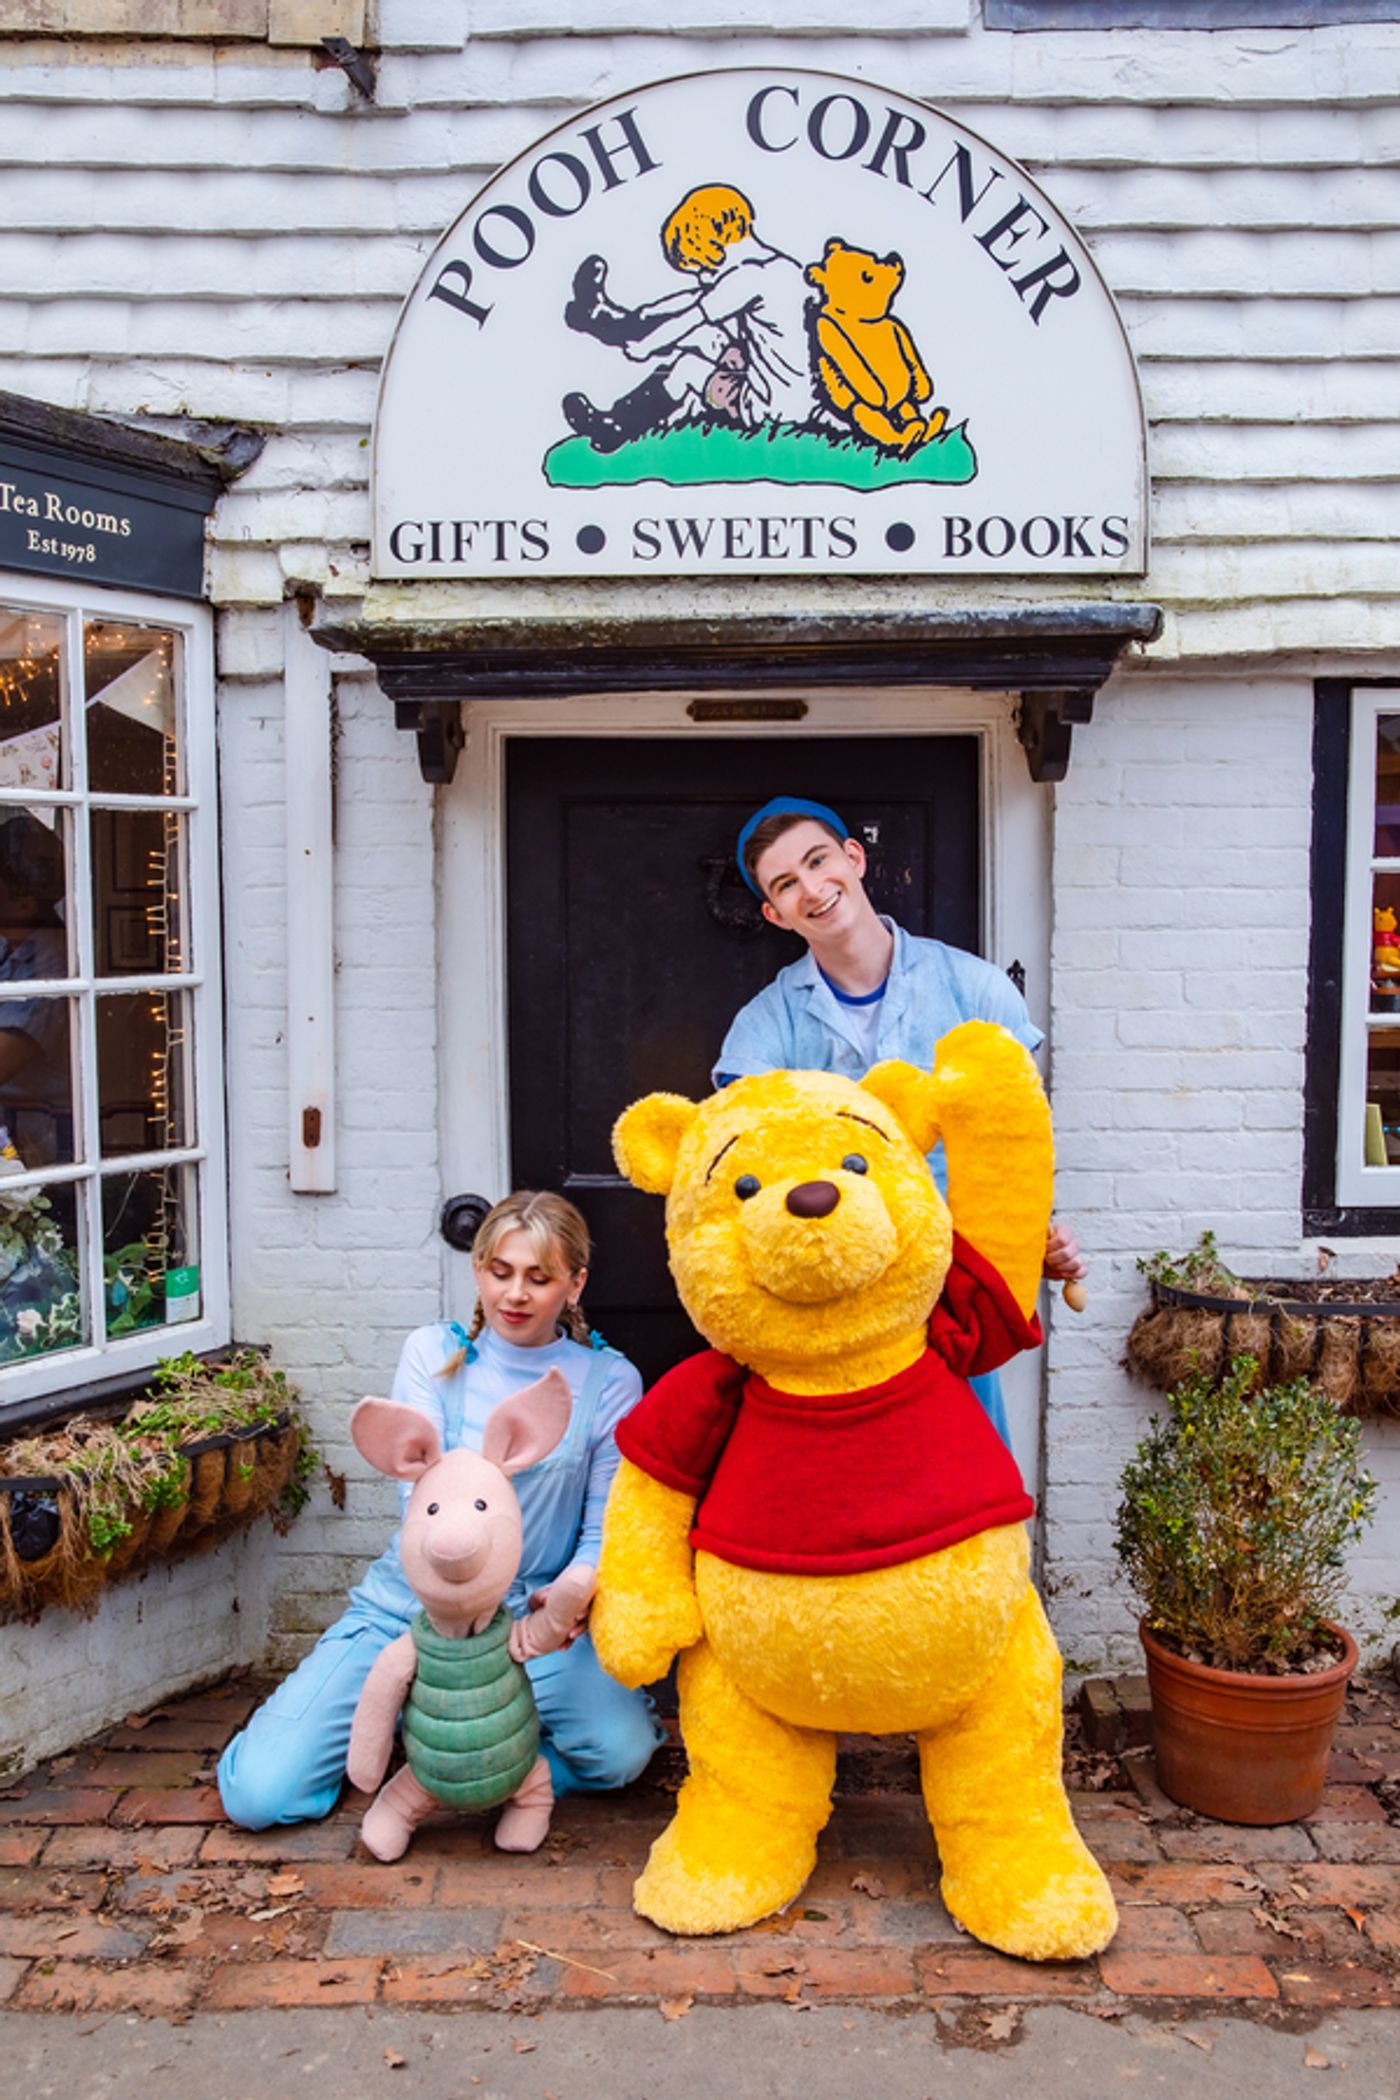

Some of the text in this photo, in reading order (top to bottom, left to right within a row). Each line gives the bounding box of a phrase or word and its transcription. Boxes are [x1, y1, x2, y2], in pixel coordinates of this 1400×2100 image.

[426, 86, 1082, 327] POOH CORNER
[0, 482, 131, 536] Tea Rooms
[27, 529, 97, 563] Est 1978
[390, 515, 1131, 563] GIFTS SWEETS BOOKS
